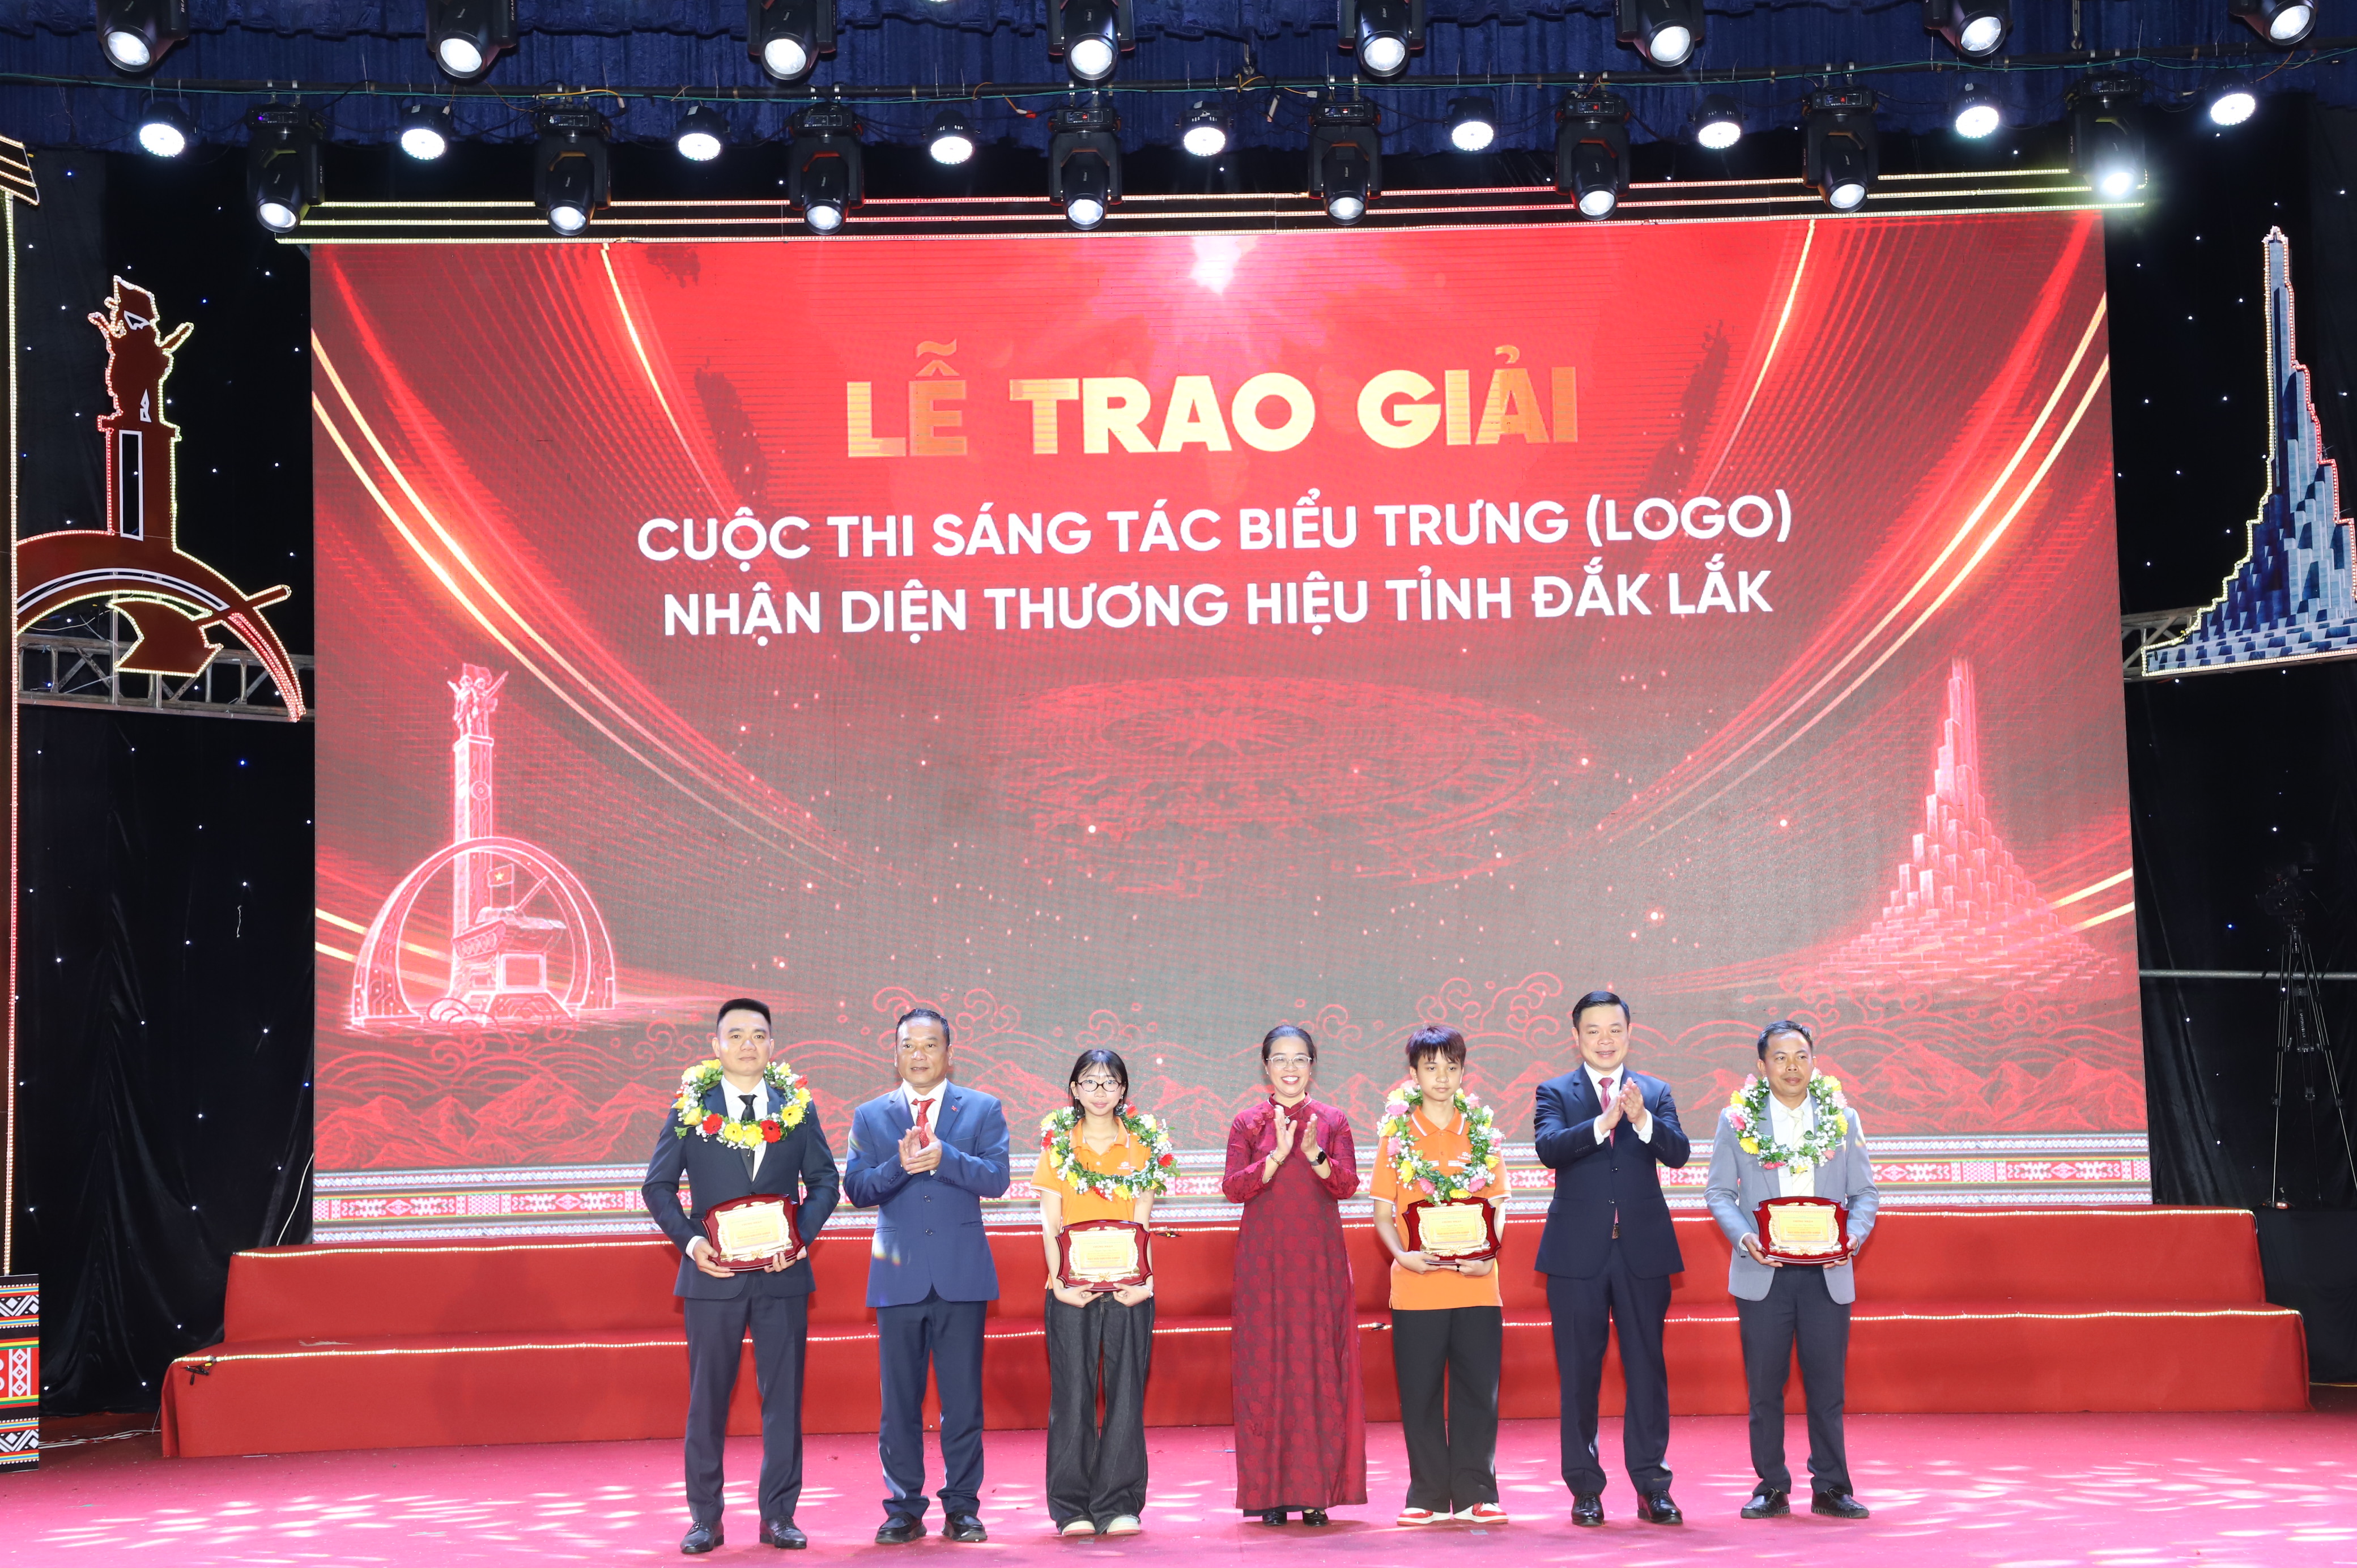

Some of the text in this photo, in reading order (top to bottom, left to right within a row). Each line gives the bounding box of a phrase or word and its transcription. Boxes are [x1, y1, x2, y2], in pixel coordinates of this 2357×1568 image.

[846, 338, 1579, 458] LỄ TRAO GIẢI
[638, 488, 1792, 572] CUỘC THI SÁNG TÁC BIỂU TRƯNG (LOGO)
[665, 553, 1773, 646] NHẬN DIỆN THƯƠNG HIỆU TỈNH ĐẮK LẮK
